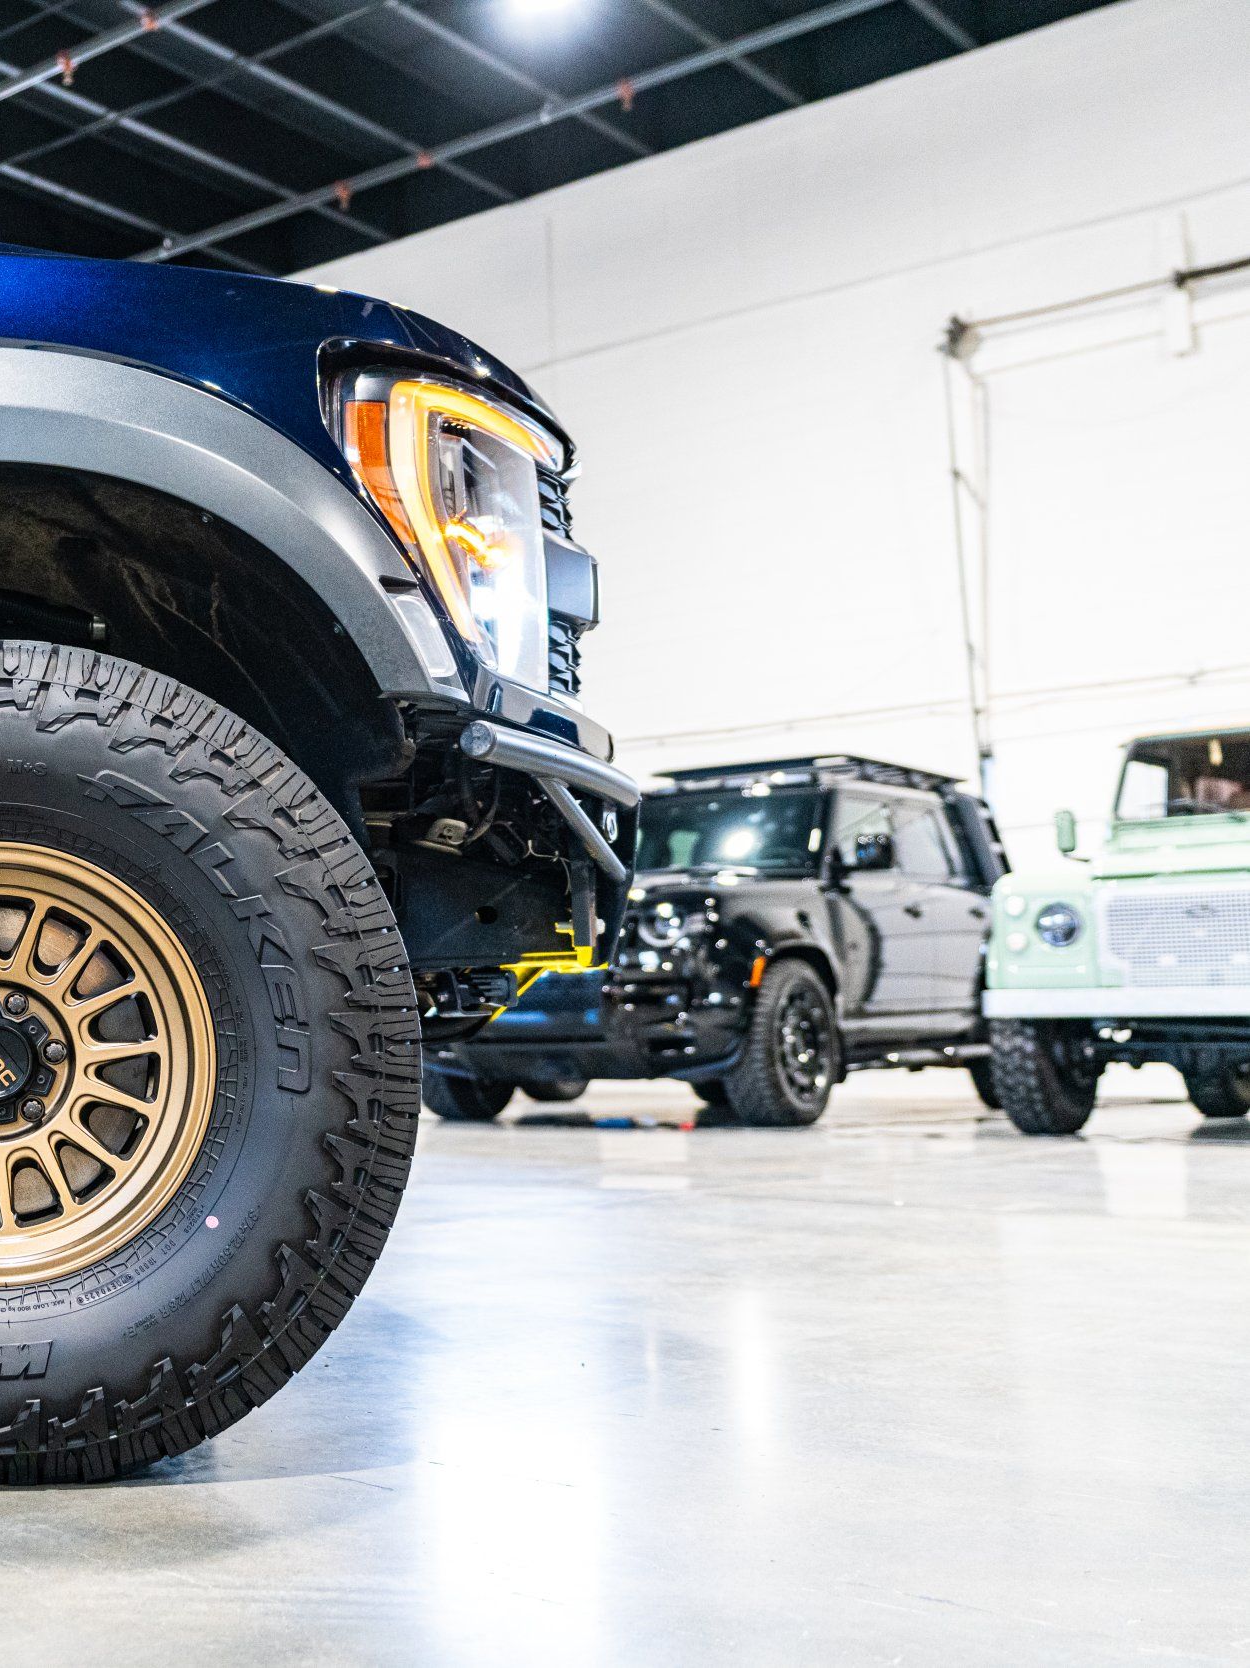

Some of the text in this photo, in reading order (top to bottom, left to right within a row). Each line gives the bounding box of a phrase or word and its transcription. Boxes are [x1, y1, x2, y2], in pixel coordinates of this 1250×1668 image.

[7, 758, 48, 777] M+S
[76, 771, 312, 1094] FALKEN
[160, 1239, 177, 1255] DOT
[7, 1305, 16, 1313] kg
[32, 1302, 49, 1310] LOAD
